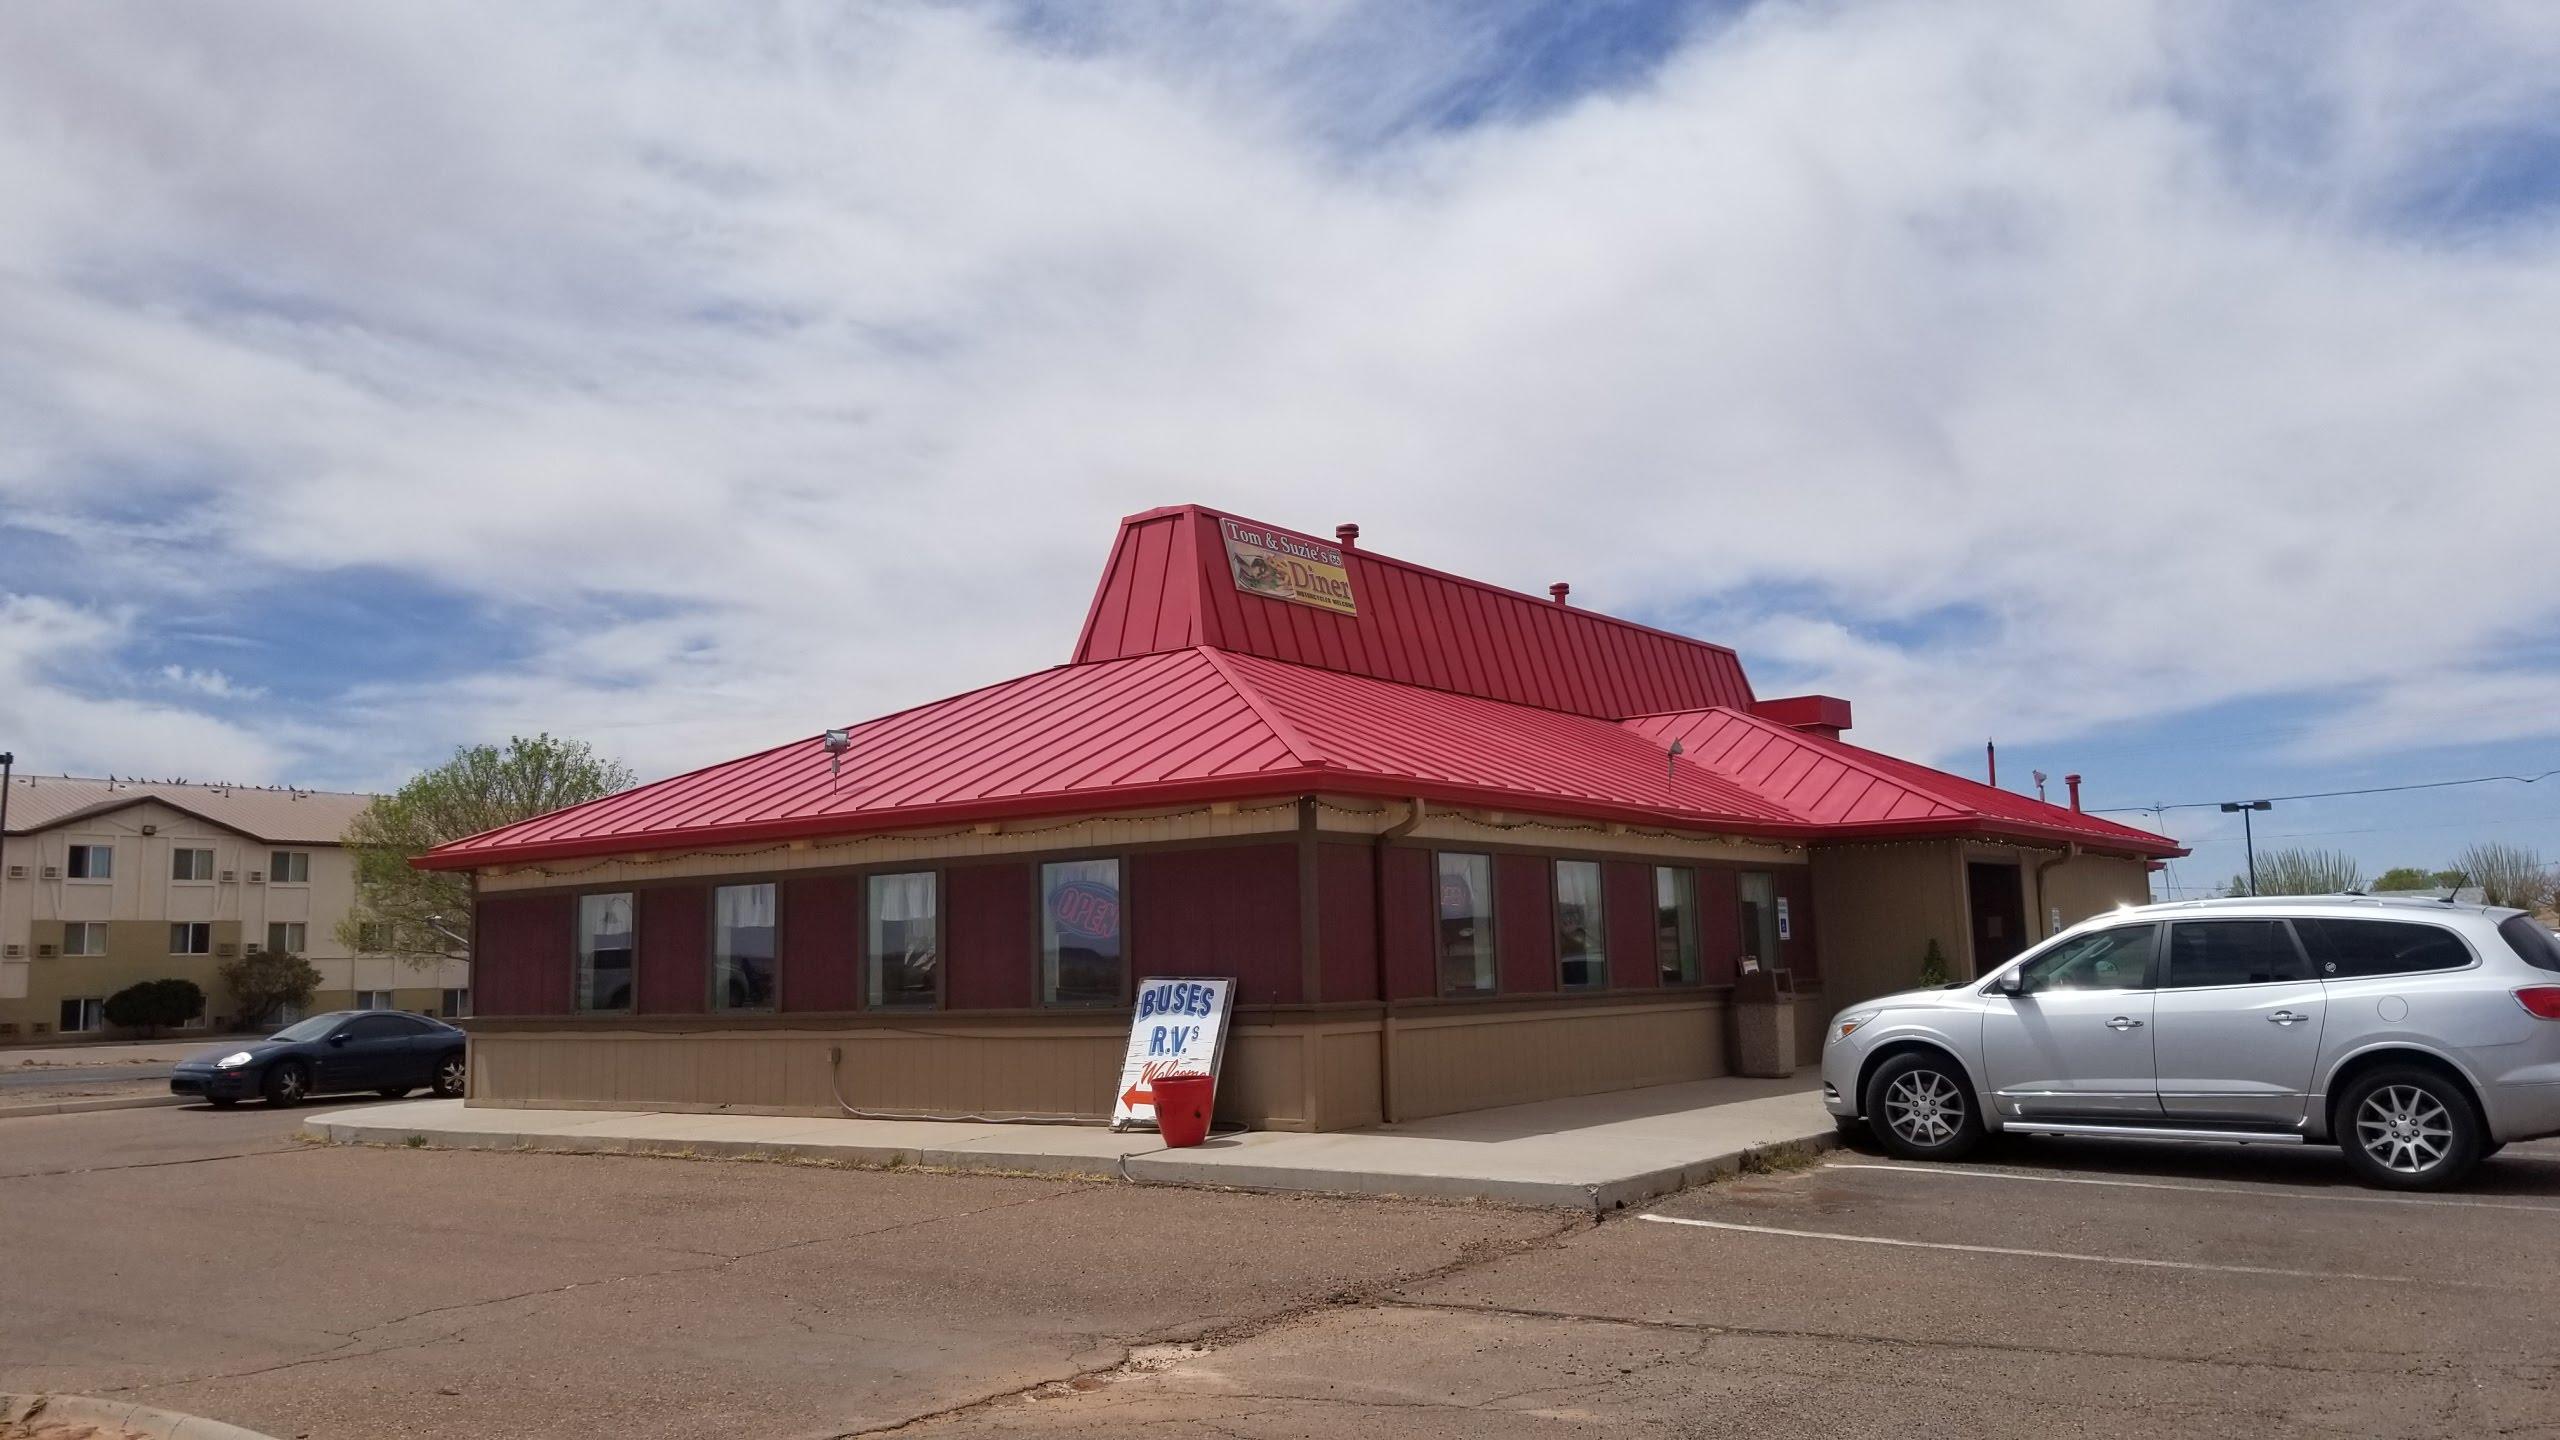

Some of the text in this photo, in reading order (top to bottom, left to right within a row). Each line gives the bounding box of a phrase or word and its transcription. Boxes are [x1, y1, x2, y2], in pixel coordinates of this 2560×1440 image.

[1227, 523, 1328, 563] Tom & Suzie's
[1288, 561, 1350, 599] Diner
[1057, 887, 1118, 938] OPEN
[1139, 983, 1214, 1022] BUSES
